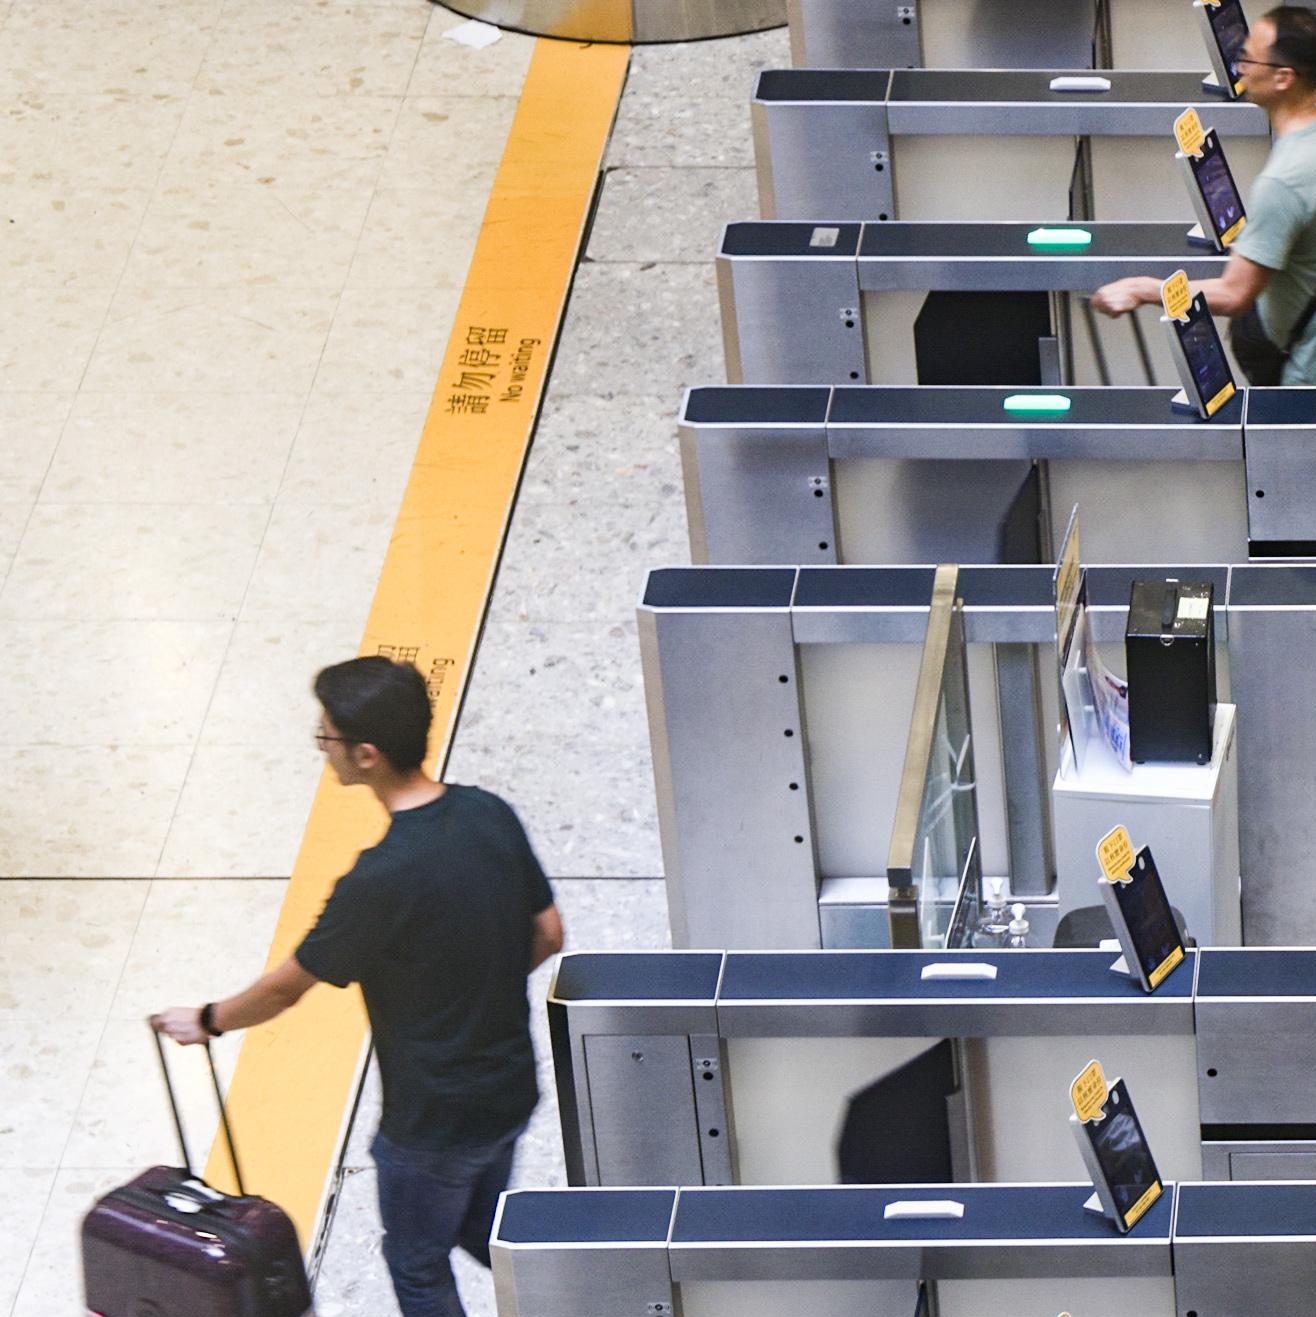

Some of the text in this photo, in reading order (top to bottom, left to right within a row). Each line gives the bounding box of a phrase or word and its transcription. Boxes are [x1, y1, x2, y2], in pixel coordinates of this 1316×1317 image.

[444, 326, 508, 414] 請勿停留
[498, 338, 541, 402] No waiting
